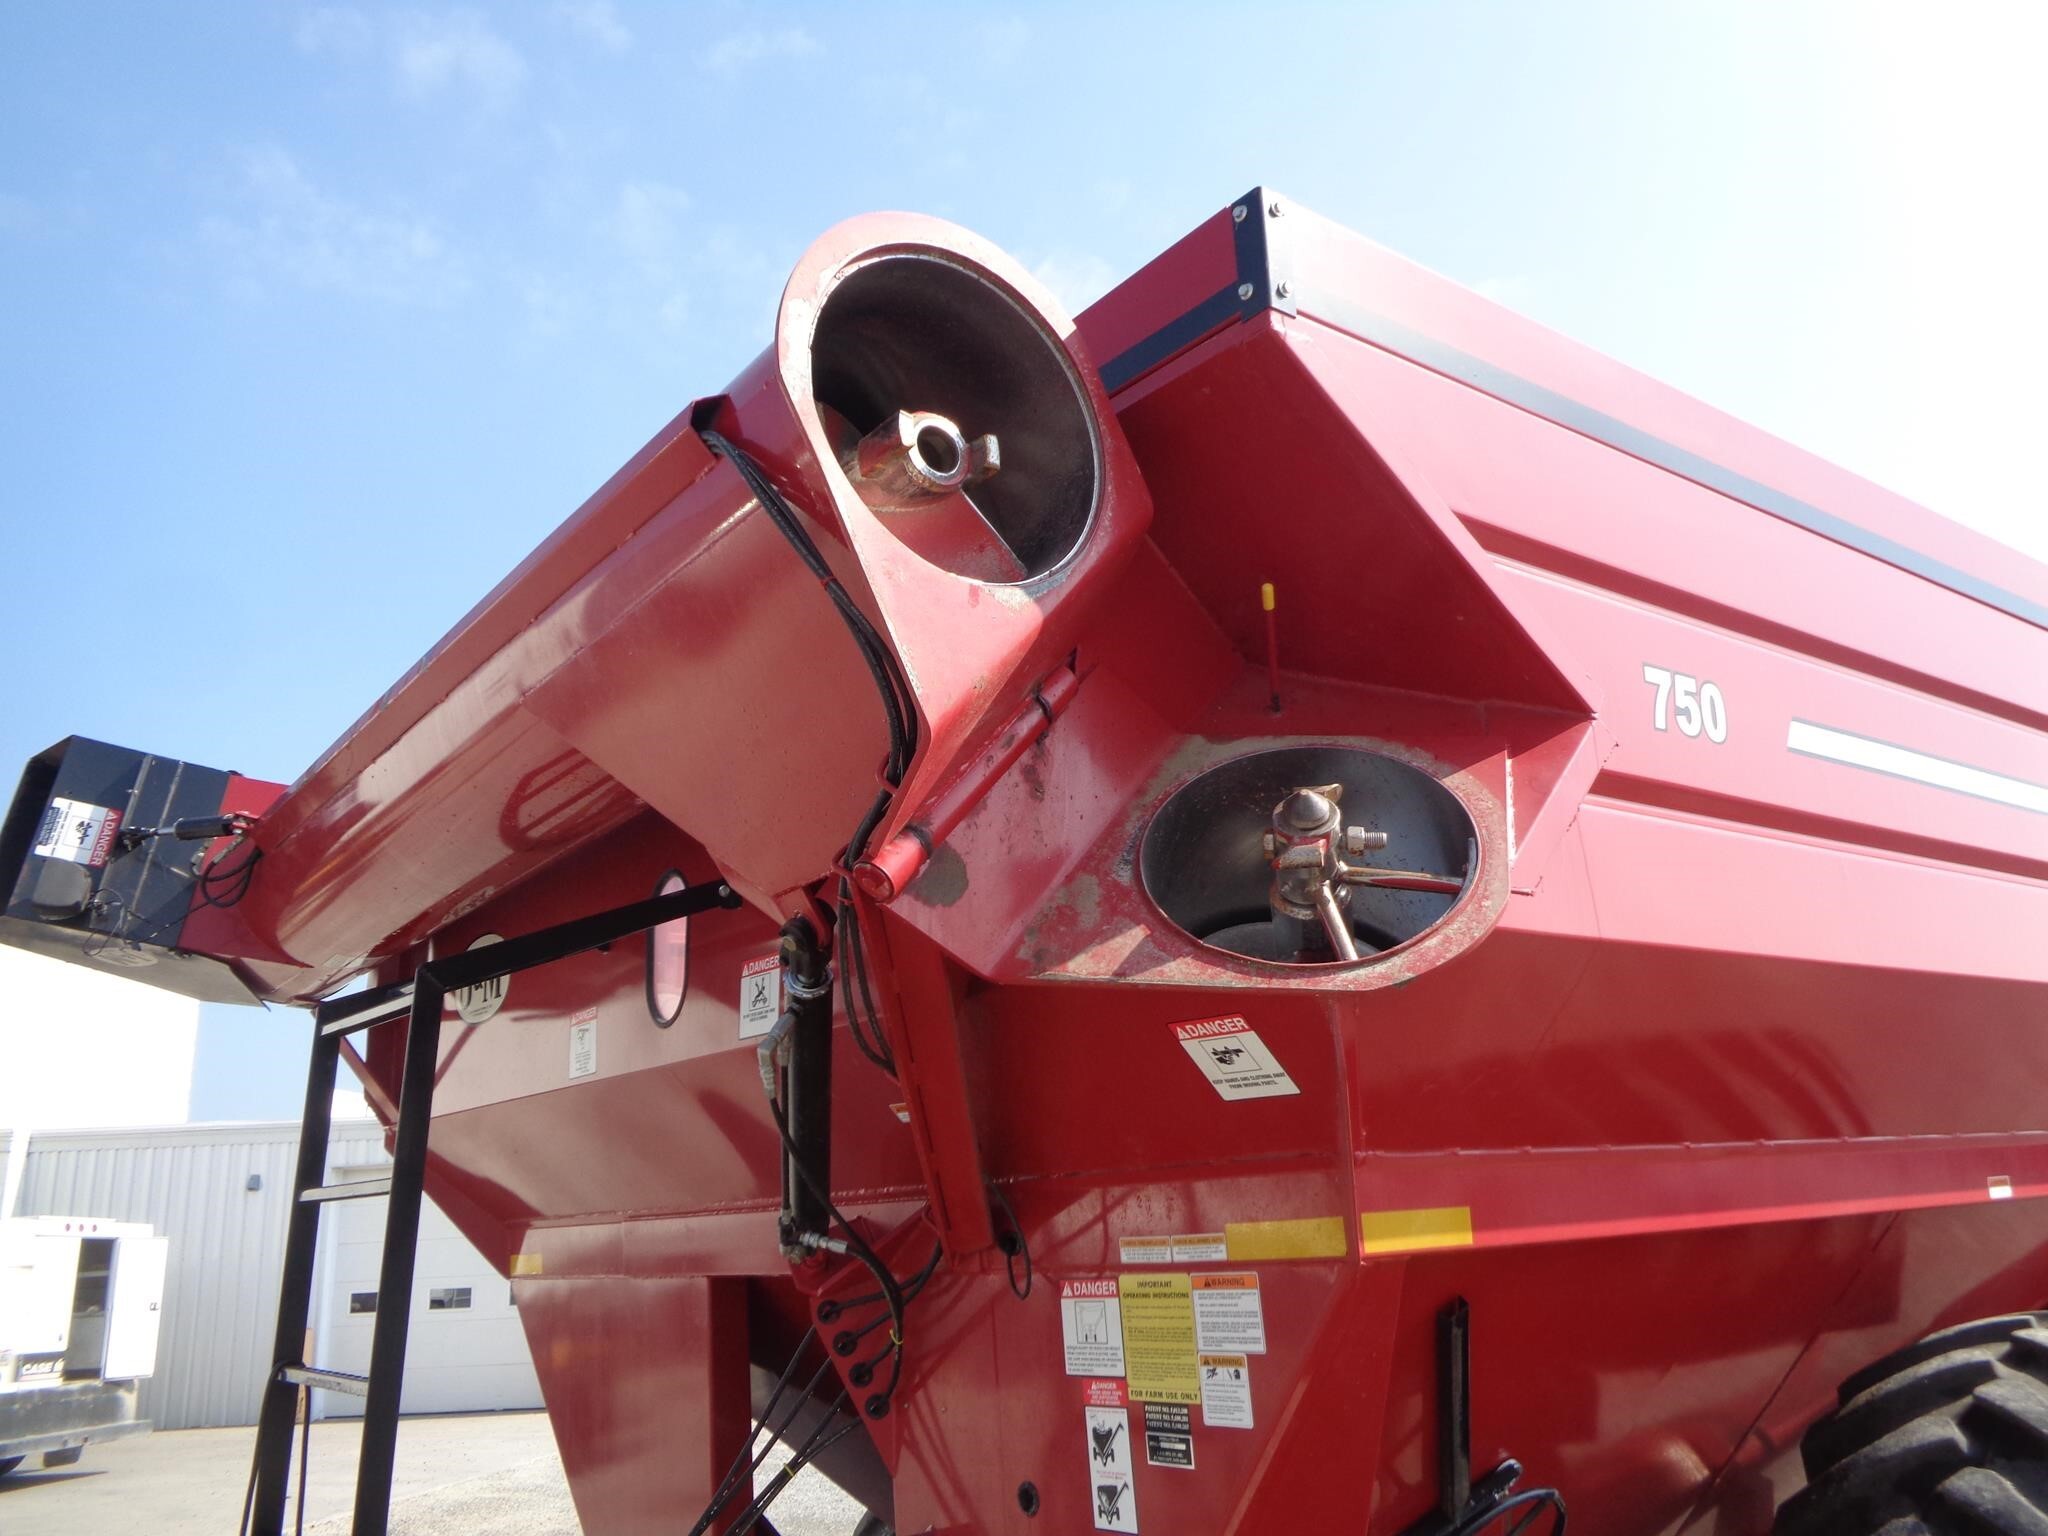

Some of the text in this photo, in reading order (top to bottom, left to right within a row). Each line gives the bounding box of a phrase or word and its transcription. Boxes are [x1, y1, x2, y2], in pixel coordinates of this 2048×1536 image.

[1641, 662, 1728, 745] 750
[90, 822, 115, 866] DANGER
[749, 955, 780, 974] DANGER
[1185, 1017, 1249, 1037] DANGER
[1073, 1281, 1117, 1296] DANGER
[1136, 1280, 1173, 1289] IMPORTANT
[1211, 1277, 1246, 1287] WARNING
[1212, 1357, 1244, 1367] WARNING
[1145, 1390, 1164, 1399] FARM
[1165, 1391, 1179, 1399] USE
[1181, 1391, 1198, 1400] ONLY
